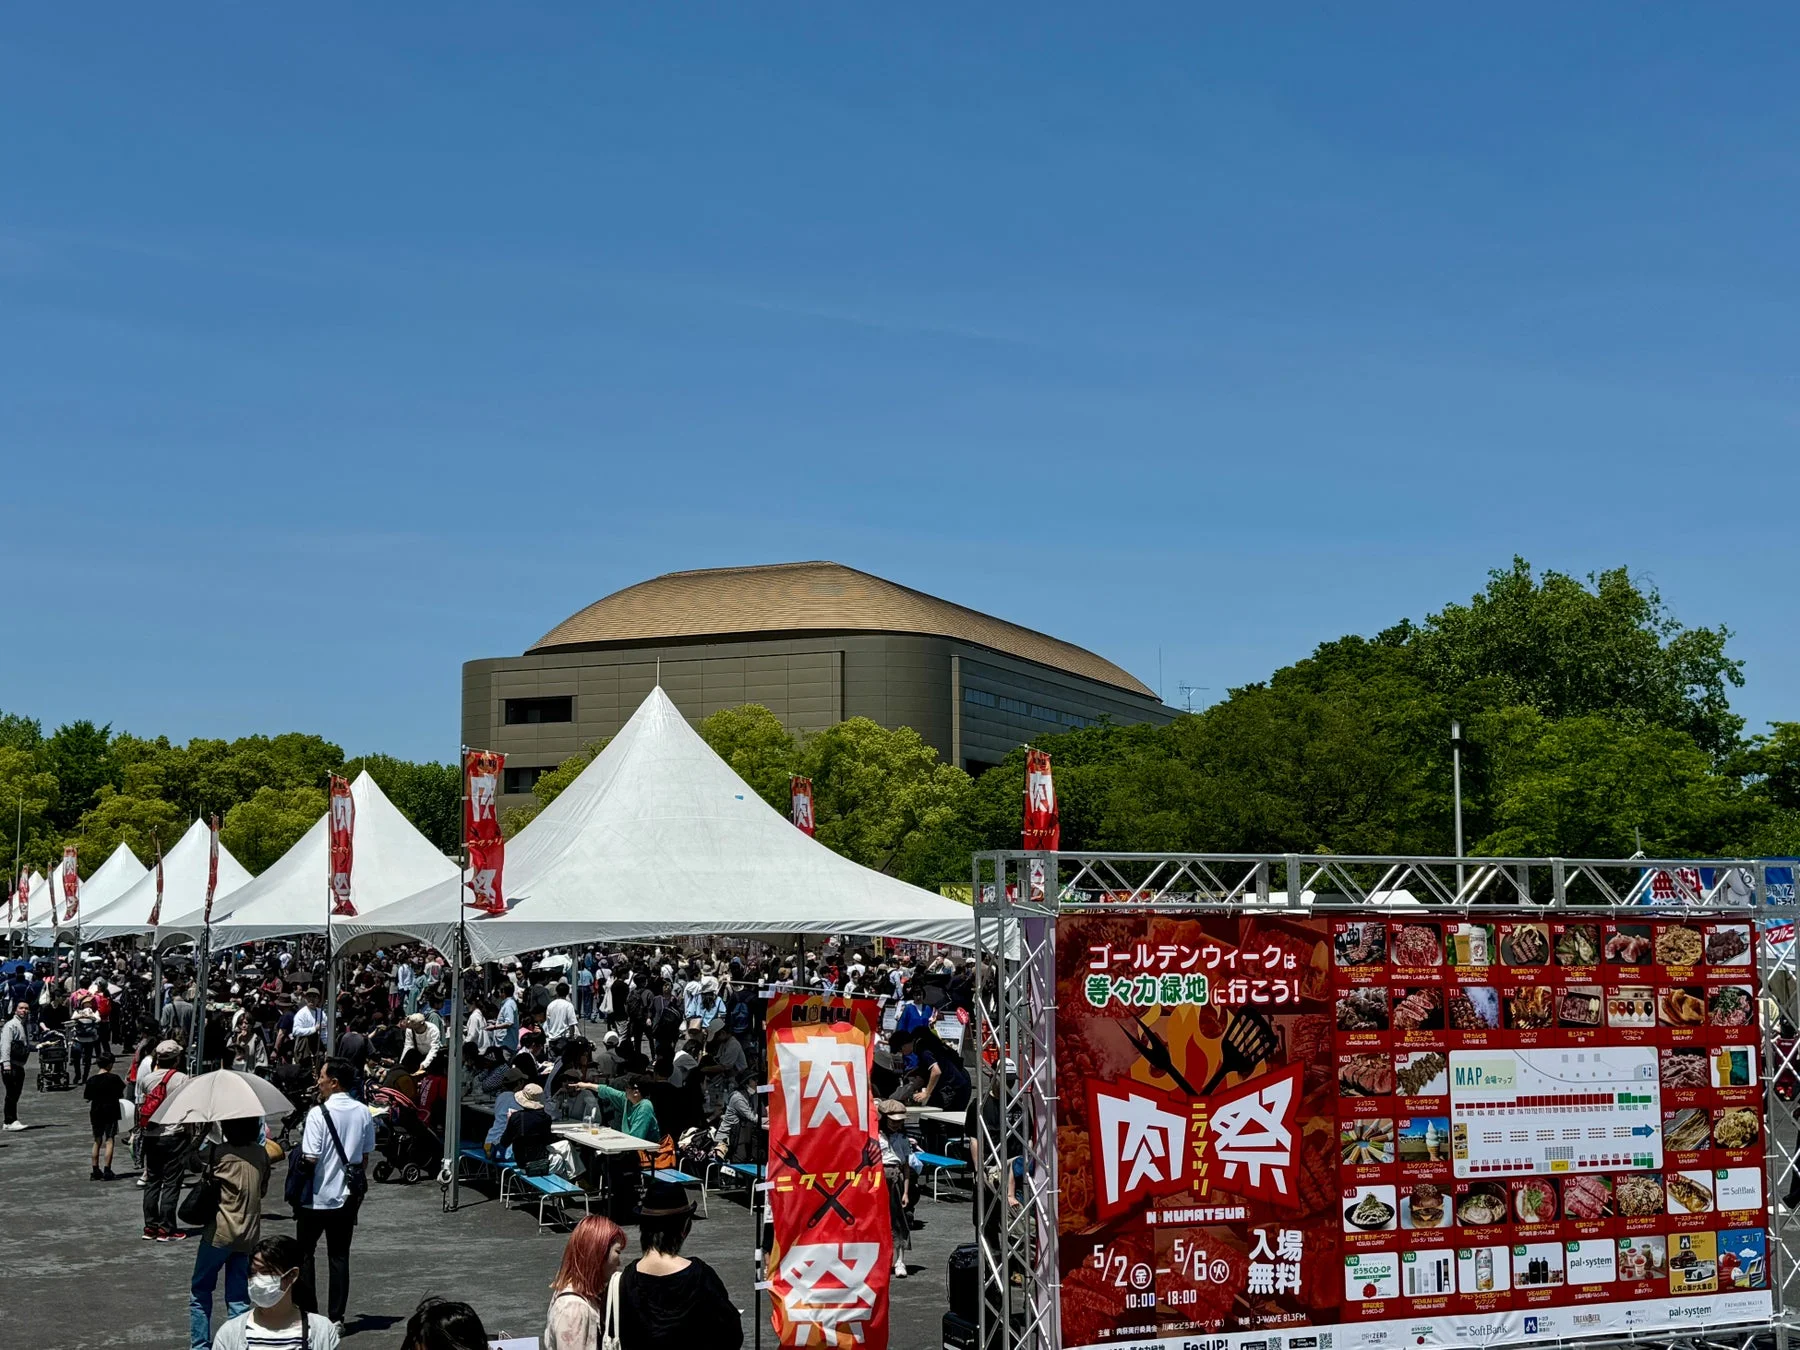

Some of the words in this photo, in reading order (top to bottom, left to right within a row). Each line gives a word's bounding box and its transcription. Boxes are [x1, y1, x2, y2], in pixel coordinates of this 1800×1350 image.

[1030, 771, 1054, 814] 肉
[1089, 942, 1298, 970] ゴールデンウィークは
[1504, 988, 1515, 996] T12
[1339, 1055, 1351, 1063] K03
[1455, 1067, 1483, 1086] MAP
[775, 1036, 869, 1137] 肉
[1341, 1121, 1353, 1130] K07
[1209, 1076, 1294, 1195] 祭
[1097, 1092, 1188, 1205] 肉
[1191, 1103, 1209, 1196] ニクマツリ
[776, 1171, 882, 1193] ニクマツリ
[1564, 1178, 1576, 1186] K15
[1344, 1189, 1356, 1197] K11
[1401, 1186, 1413, 1194] K12
[1731, 1186, 1756, 1196] SoftBank
[1249, 1228, 1303, 1262] 入場
[1619, 1239, 1630, 1248] V07
[1345, 1256, 1357, 1265] V02
[1459, 1250, 1471, 1258] V04
[1353, 1266, 1391, 1275] おうちCO-OP
[1247, 1263, 1303, 1296] 無料
[779, 1242, 881, 1347] 祭
[1469, 1322, 1508, 1337] SoftBank
